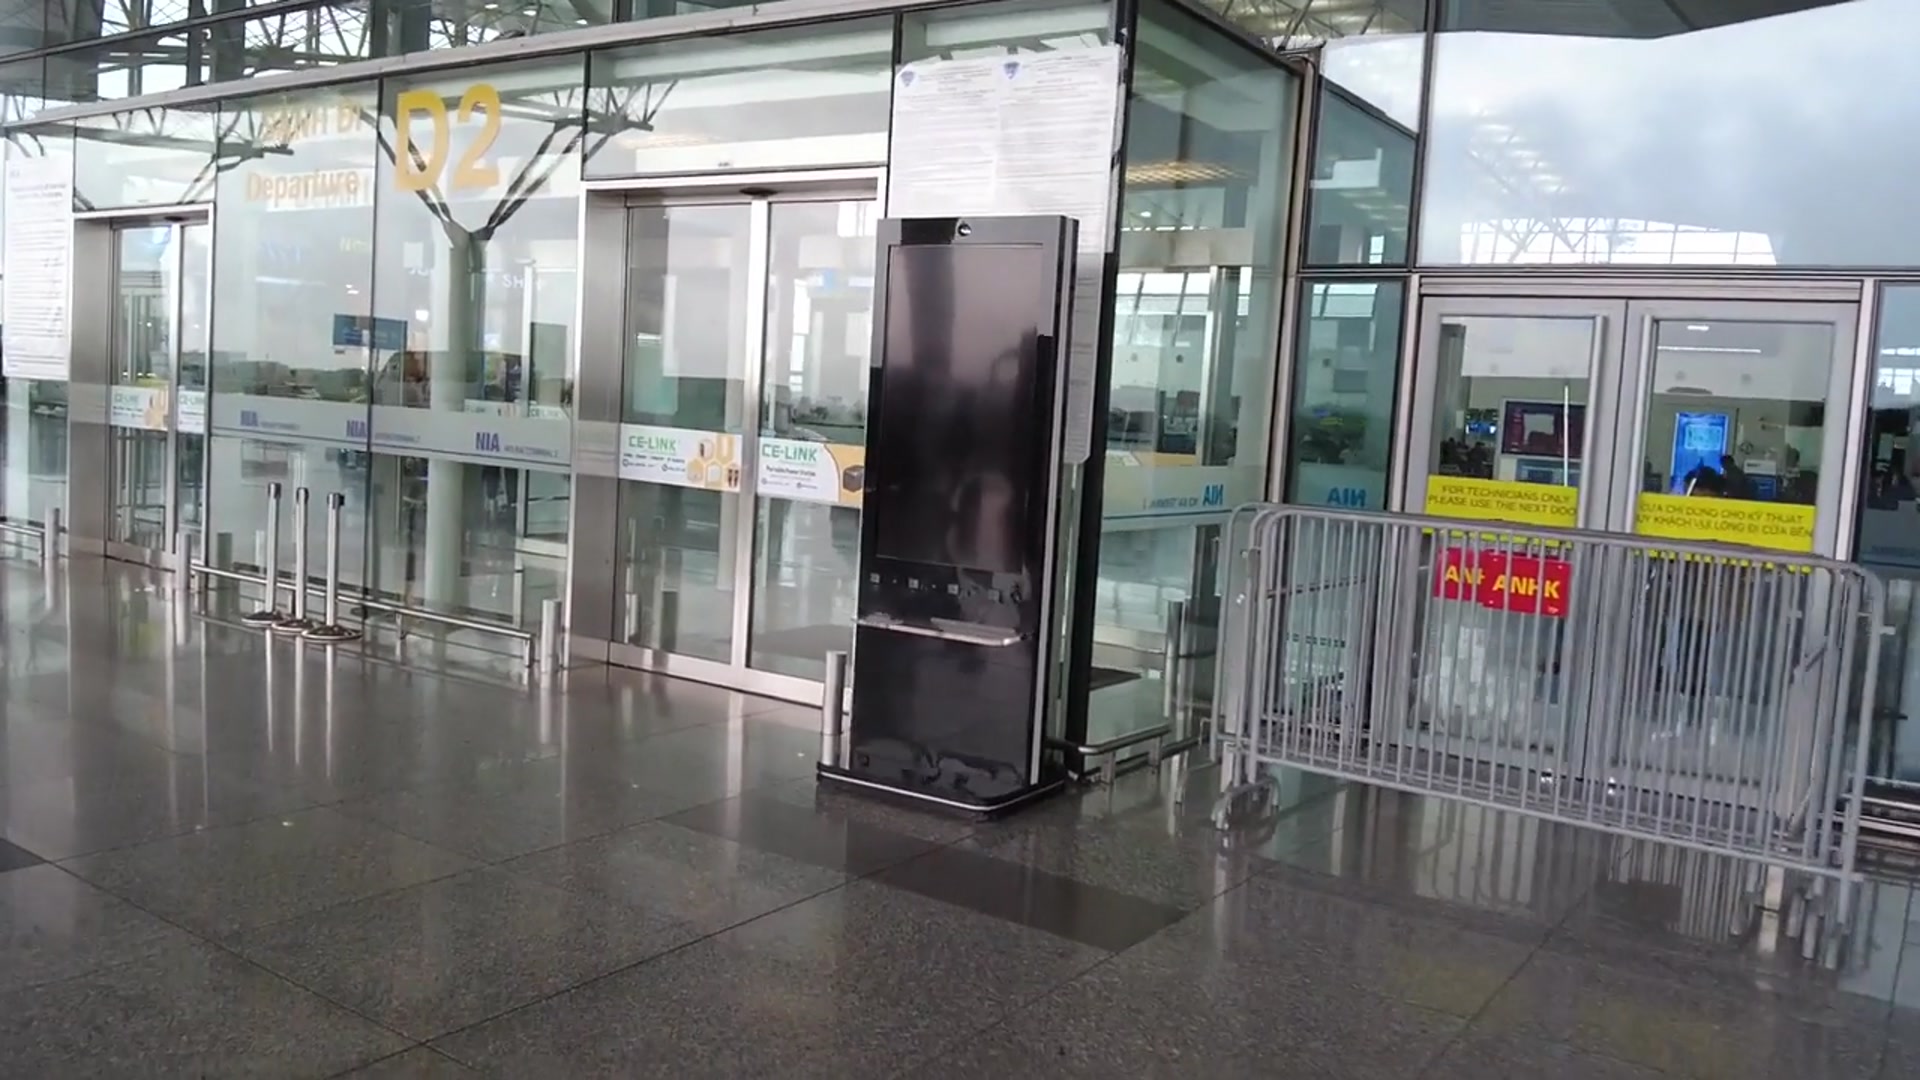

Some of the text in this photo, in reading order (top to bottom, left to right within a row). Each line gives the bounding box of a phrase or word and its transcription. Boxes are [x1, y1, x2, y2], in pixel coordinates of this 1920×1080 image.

[394, 83, 501, 192] D2
[246, 168, 360, 206] Departure
[475, 431, 501, 452] NIA
[628, 435, 677, 451] CE-LINK
[761, 443, 818, 463] CE-LINK
[1428, 494, 1576, 516] PLEASE USE THE NEXT DOO
[1442, 485, 1571, 504] FOR TECHNICIANS ONLY
